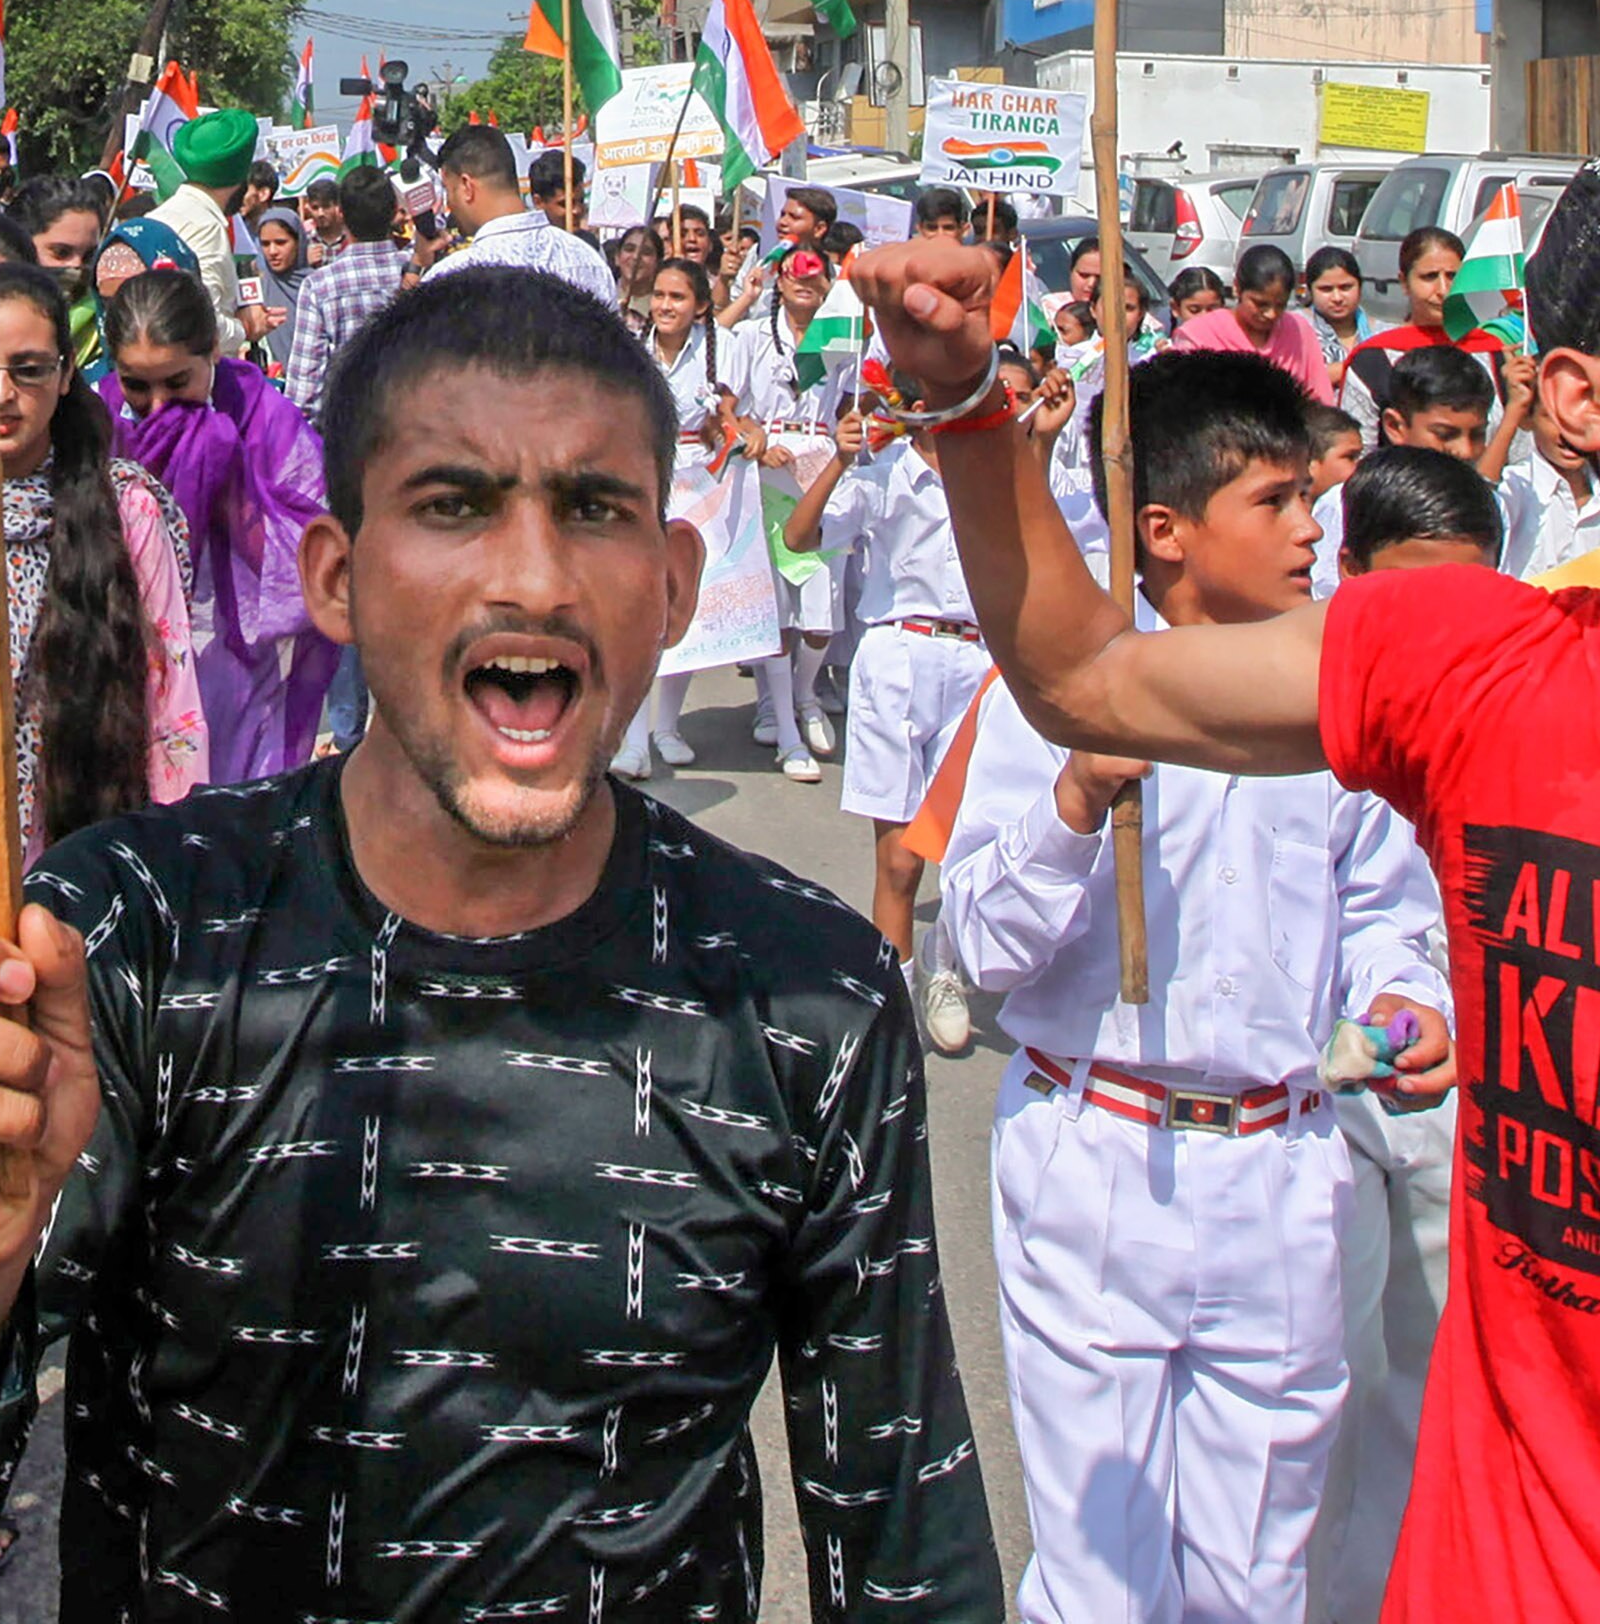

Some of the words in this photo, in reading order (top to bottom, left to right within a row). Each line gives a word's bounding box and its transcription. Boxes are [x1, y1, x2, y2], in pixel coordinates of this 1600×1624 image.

[952, 90, 994, 110] HAR
[1002, 93, 1059, 115] GHAR
[970, 112, 1061, 136] TIRANGA
[942, 169, 977, 183] JAI
[990, 171, 1054, 189] HIND
